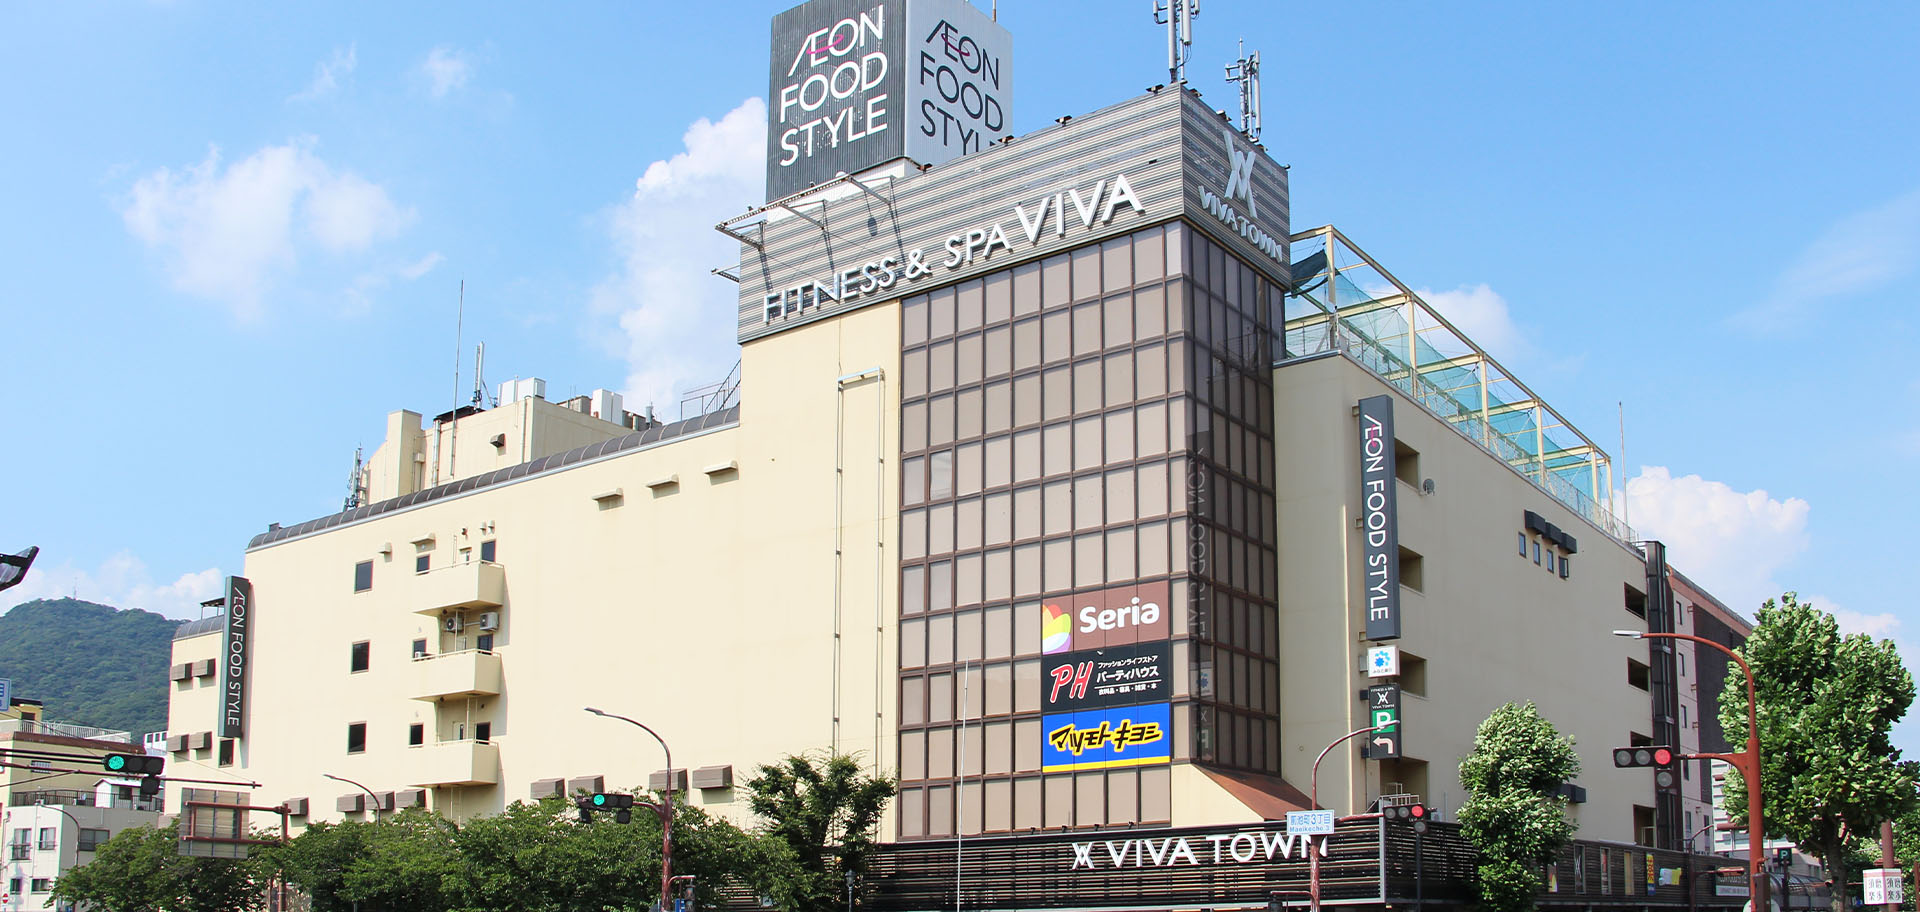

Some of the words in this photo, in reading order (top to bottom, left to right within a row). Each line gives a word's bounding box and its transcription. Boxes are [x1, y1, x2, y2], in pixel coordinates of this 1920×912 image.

[780, 51, 888, 123] FOOD
[921, 50, 1003, 132] FOOD
[780, 94, 888, 167] STYLE
[1198, 185, 1239, 232] VIVA
[1238, 215, 1283, 263] TOWN
[763, 257, 898, 324] FITNESS
[905, 248, 931, 279] &
[944, 223, 1014, 268] SPA
[1015, 173, 1146, 243] VIVA
[1367, 479, 1387, 548] FOOD
[1368, 553, 1389, 622] STYLE
[1079, 596, 1160, 634] Seria
[230, 632, 244, 678] FOOD
[1098, 655, 1159, 669] ファッションライフストア
[227, 681, 241, 727] STYLE
[1049, 661, 1094, 704] PH
[1050, 720, 1162, 755] マツモトキヨシ
[1376, 711, 1391, 732] P
[1105, 837, 1199, 868] VIVA
